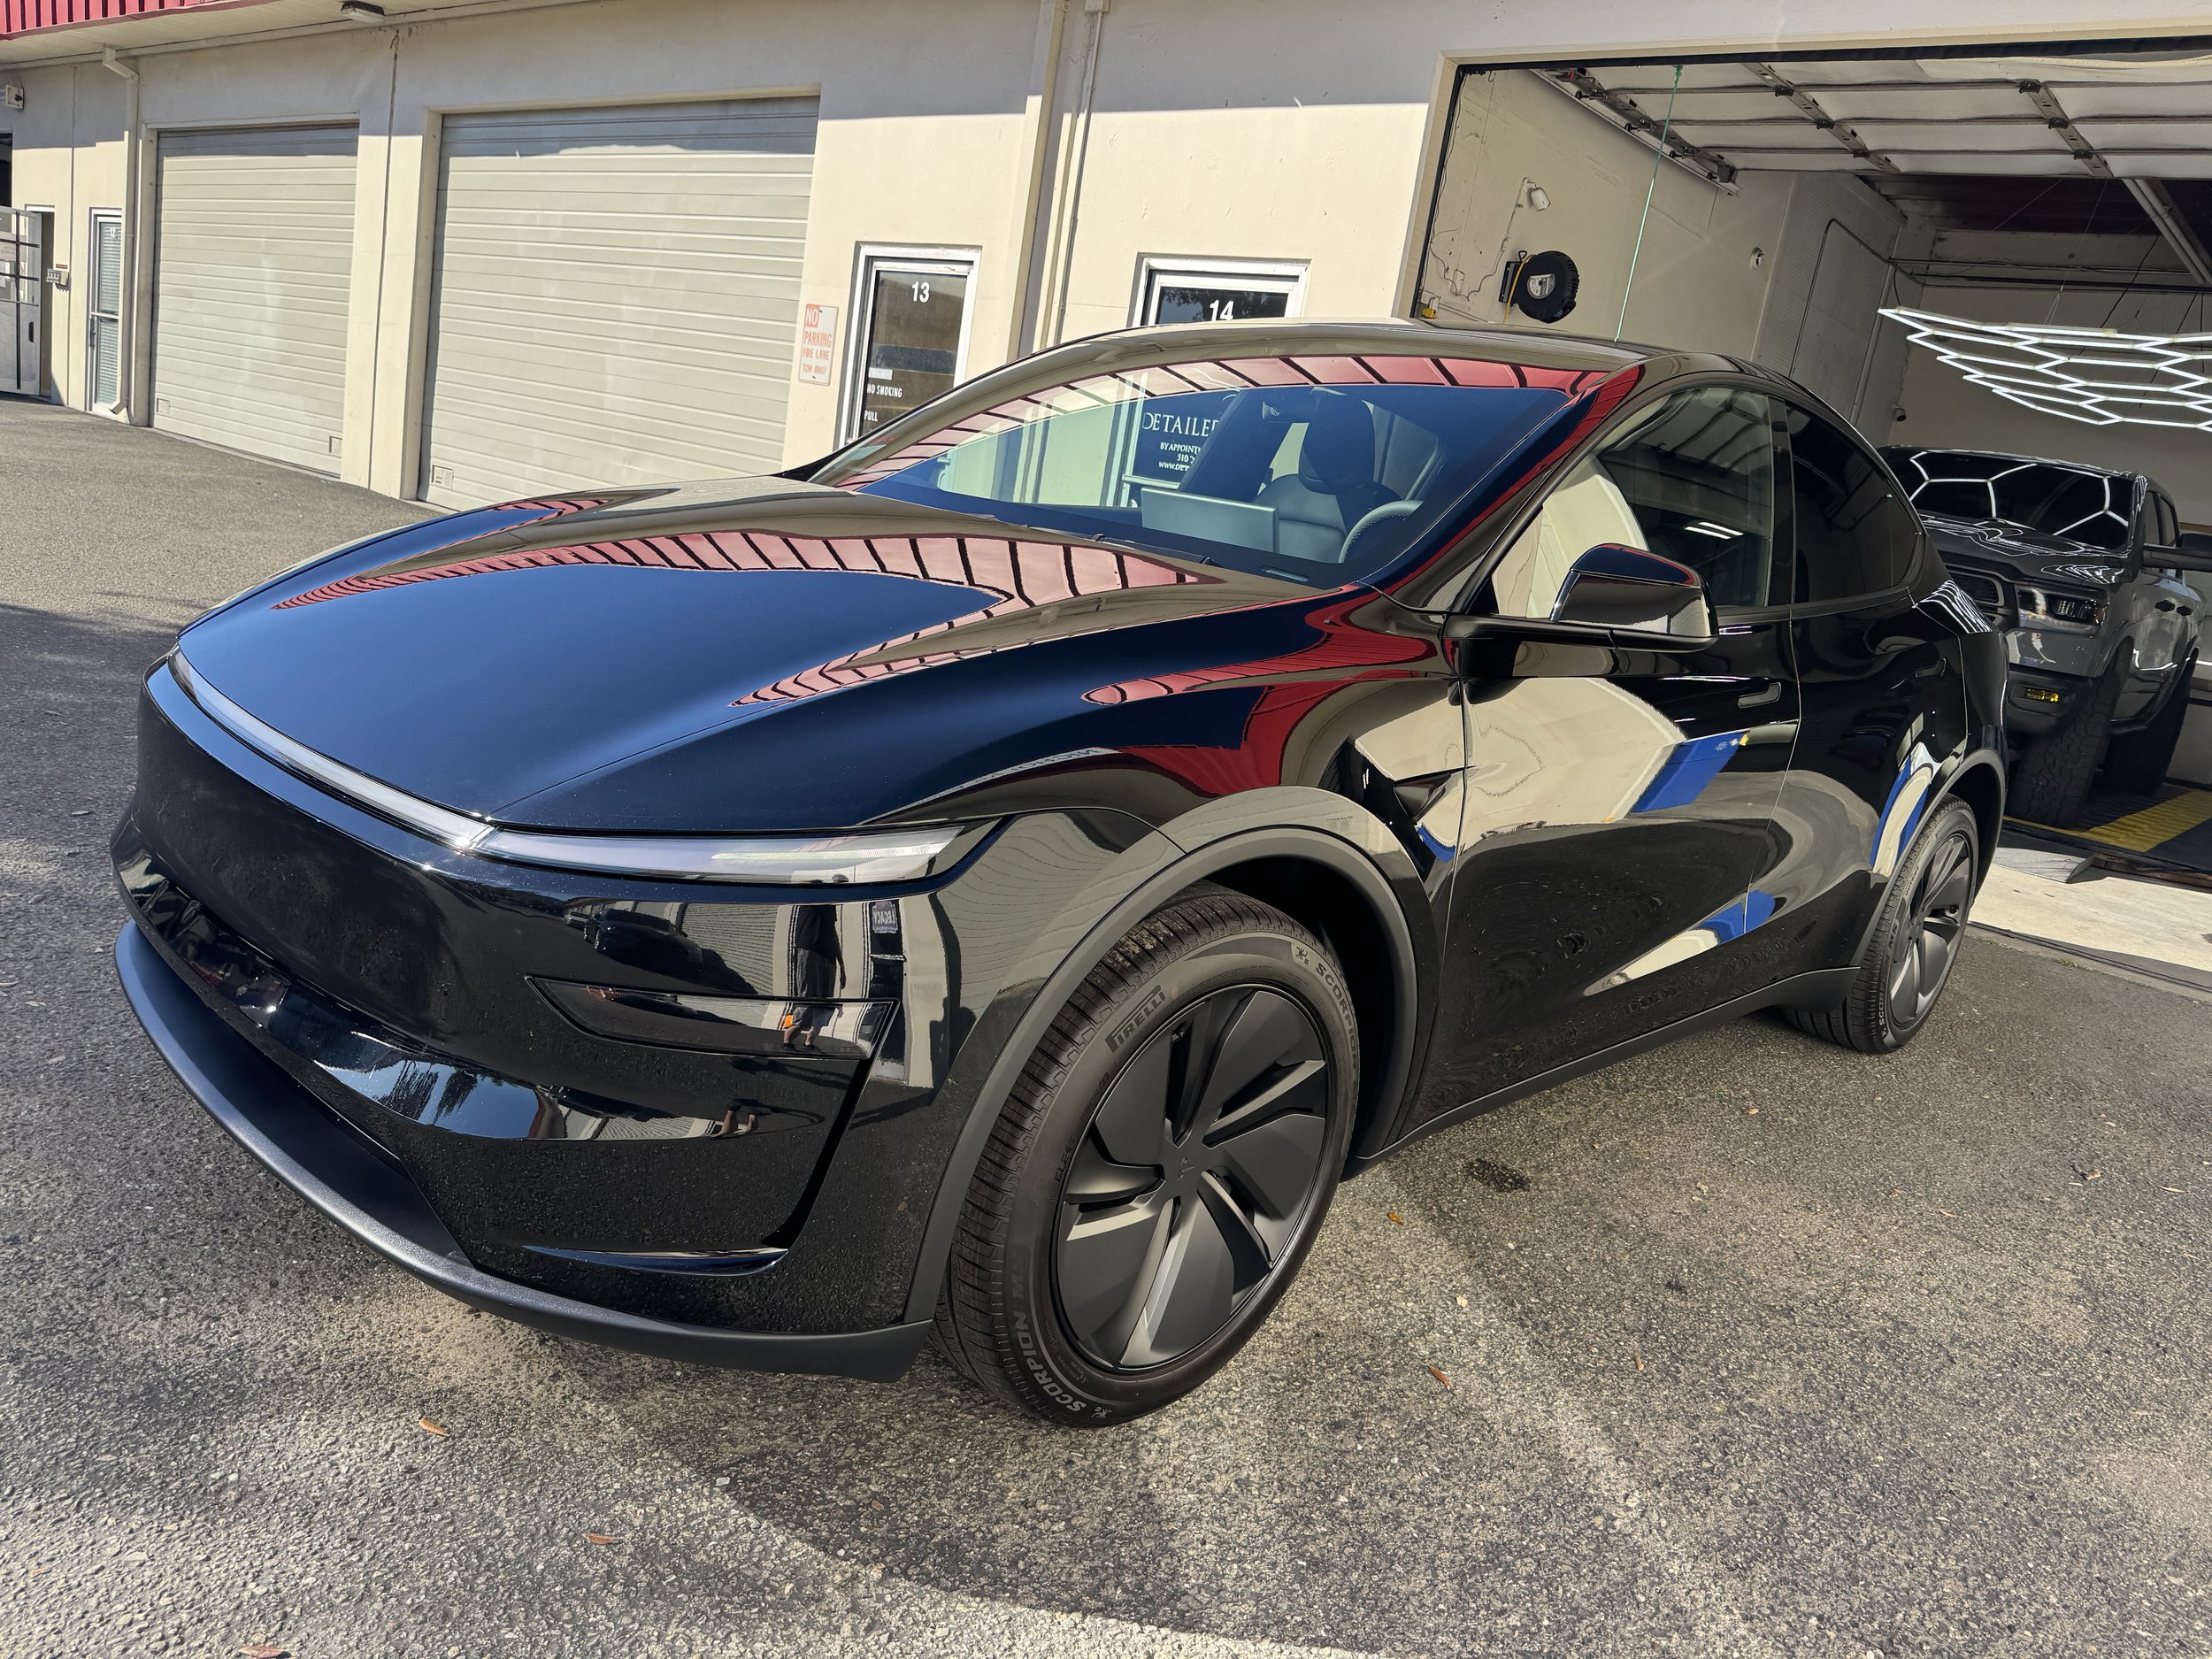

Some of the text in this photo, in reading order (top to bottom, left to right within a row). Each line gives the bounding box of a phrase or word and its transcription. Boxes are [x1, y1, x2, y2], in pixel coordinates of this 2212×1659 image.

[912, 281, 930, 303] 13
[806, 308, 818, 326] NO
[1210, 300, 1234, 321] 14
[804, 331, 833, 348] PARKING
[803, 348, 830, 361] FIRE LANE
[803, 364, 812, 373] TOW
[867, 383, 903, 398] NO SMOKING
[864, 410, 879, 422] PULL
[1160, 442, 1169, 451] BY
[1177, 453, 1189, 463] 510
[1105, 985, 1166, 1053] PIRELLI
[1315, 962, 1357, 1070] SCORPION
[1012, 1310, 1087, 1412] SCORPION
